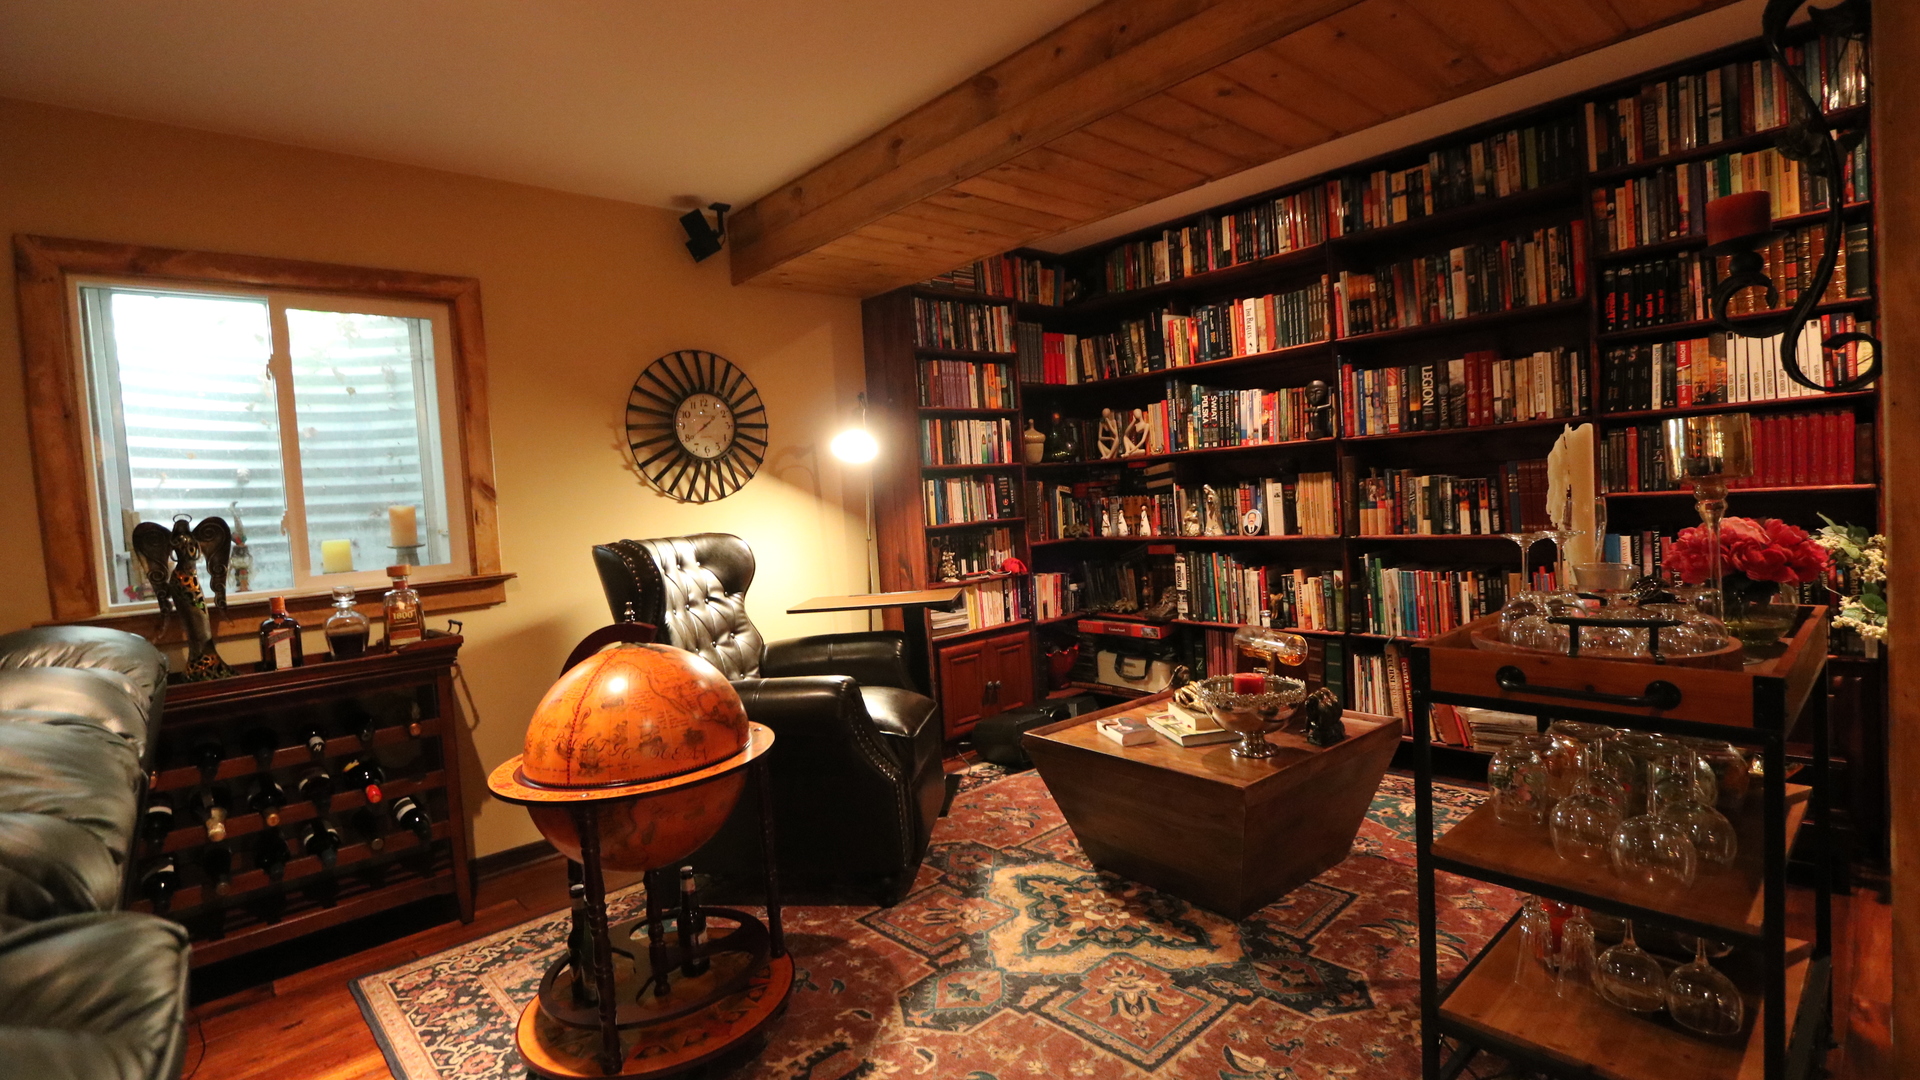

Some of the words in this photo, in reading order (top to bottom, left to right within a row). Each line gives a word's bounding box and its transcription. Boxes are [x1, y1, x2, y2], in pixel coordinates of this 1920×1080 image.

[1246, 317, 1254, 339] BEATLES
[1421, 365, 1434, 407] LEGION
[699, 399, 708, 407] 12
[1201, 395, 1209, 424] POLSKA
[1210, 395, 1218, 421] ŚWIAT
[1440, 396, 1448, 421] HARDA
[720, 410, 727, 418] 2
[684, 434, 691, 442] 8
[693, 443, 699, 452] 7
[704, 445, 710, 454] 6
[1652, 530, 1660, 541] JAN
[393, 609, 414, 620] 1800
[1386, 653, 1395, 683] KUCHNI
[1401, 661, 1409, 684] CIASTA
[1405, 690, 1413, 713] BLACHY
